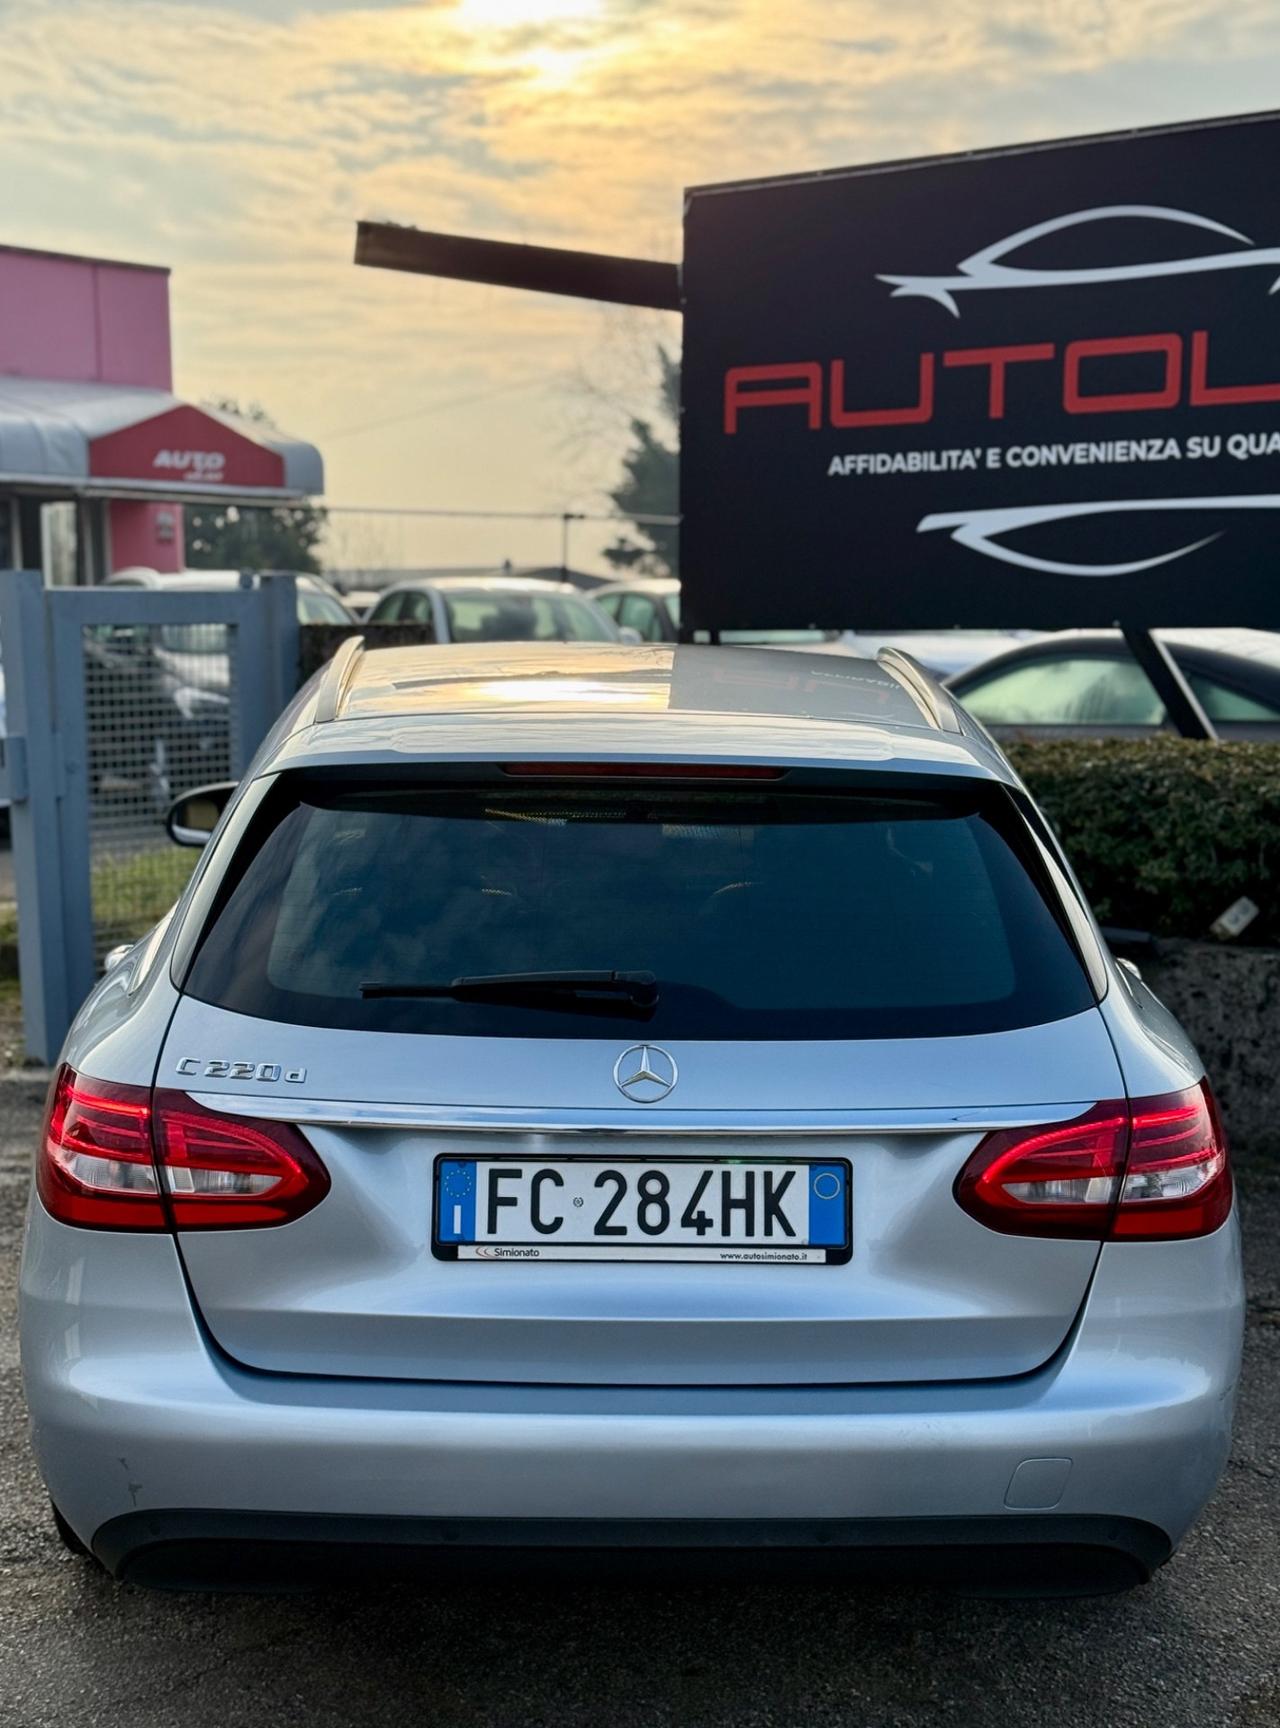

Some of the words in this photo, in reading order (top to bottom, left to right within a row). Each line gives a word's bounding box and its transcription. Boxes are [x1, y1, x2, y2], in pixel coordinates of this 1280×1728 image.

[724, 331, 1280, 433] AUTOL
[987, 448, 1001, 468] E
[1006, 438, 1182, 468] CONVENIENZA
[1186, 435, 1222, 459] SU
[1226, 432, 1280, 460] QUA
[175, 1057, 200, 1075] C
[204, 1060, 282, 1082] 220
[284, 1068, 307, 1083] d
[487, 1168, 564, 1235] FC
[594, 1169, 797, 1237] 284HK
[494, 1248, 540, 1258] Simionato
[720, 1251, 808, 1261] www.autosimionato.it
